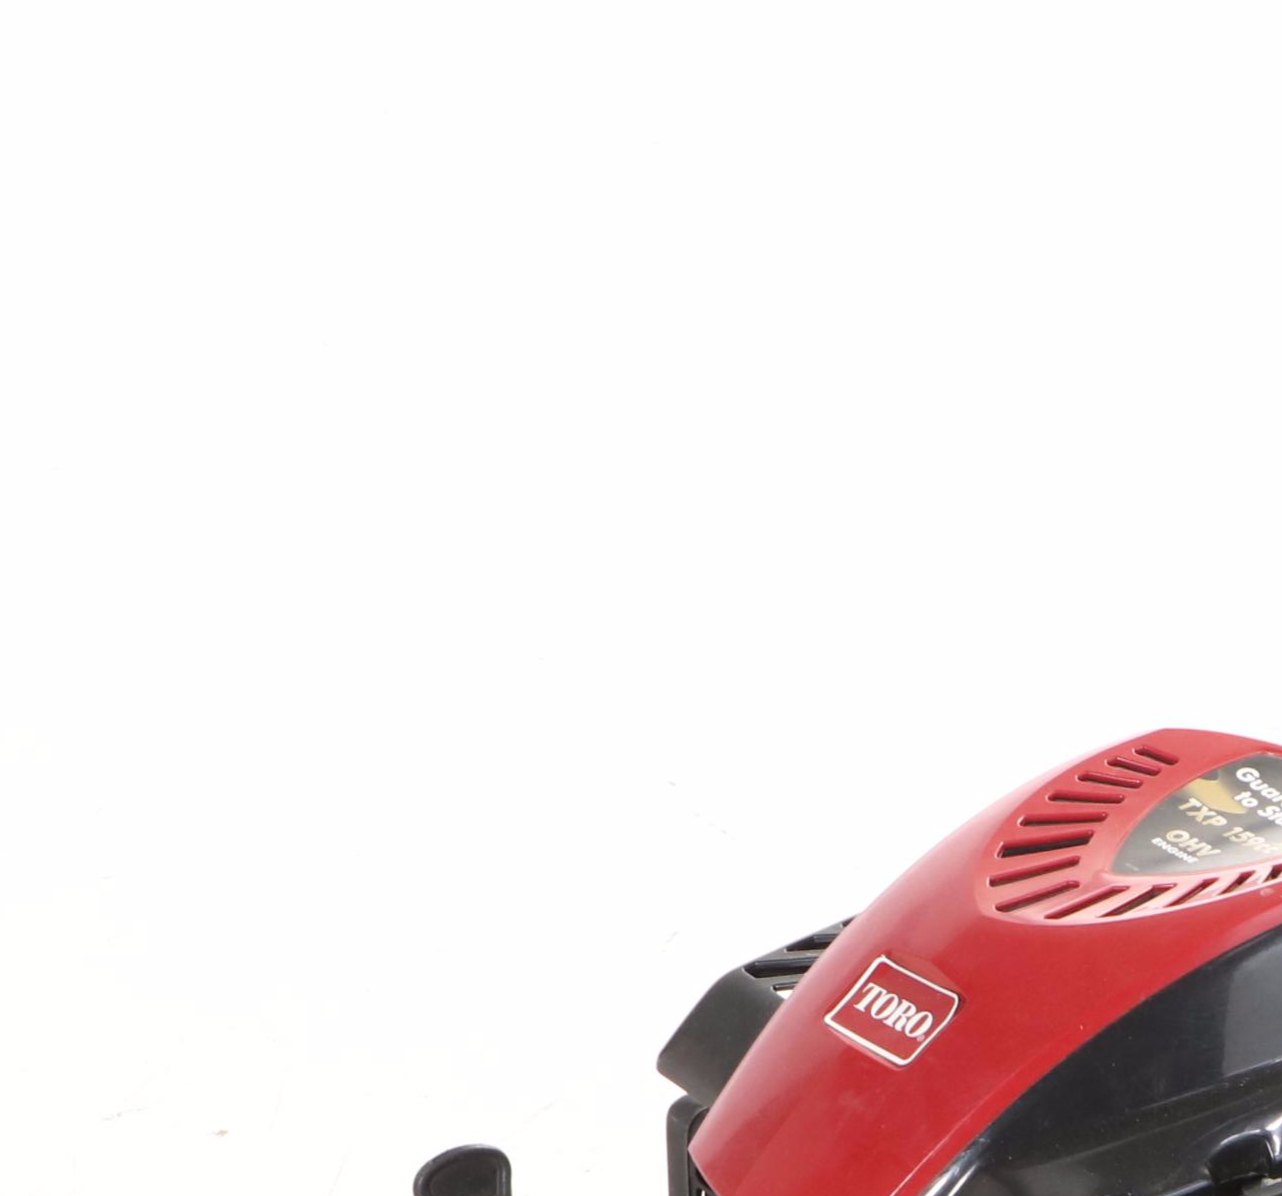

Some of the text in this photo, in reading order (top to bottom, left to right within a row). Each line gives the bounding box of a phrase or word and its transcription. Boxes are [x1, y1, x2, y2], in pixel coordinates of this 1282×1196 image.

[1177, 797, 1228, 827] TXP
[1234, 790, 1258, 809] to
[1150, 836, 1199, 863] ENGINE
[1165, 829, 1222, 858] OHV
[853, 982, 933, 1039] TORO
